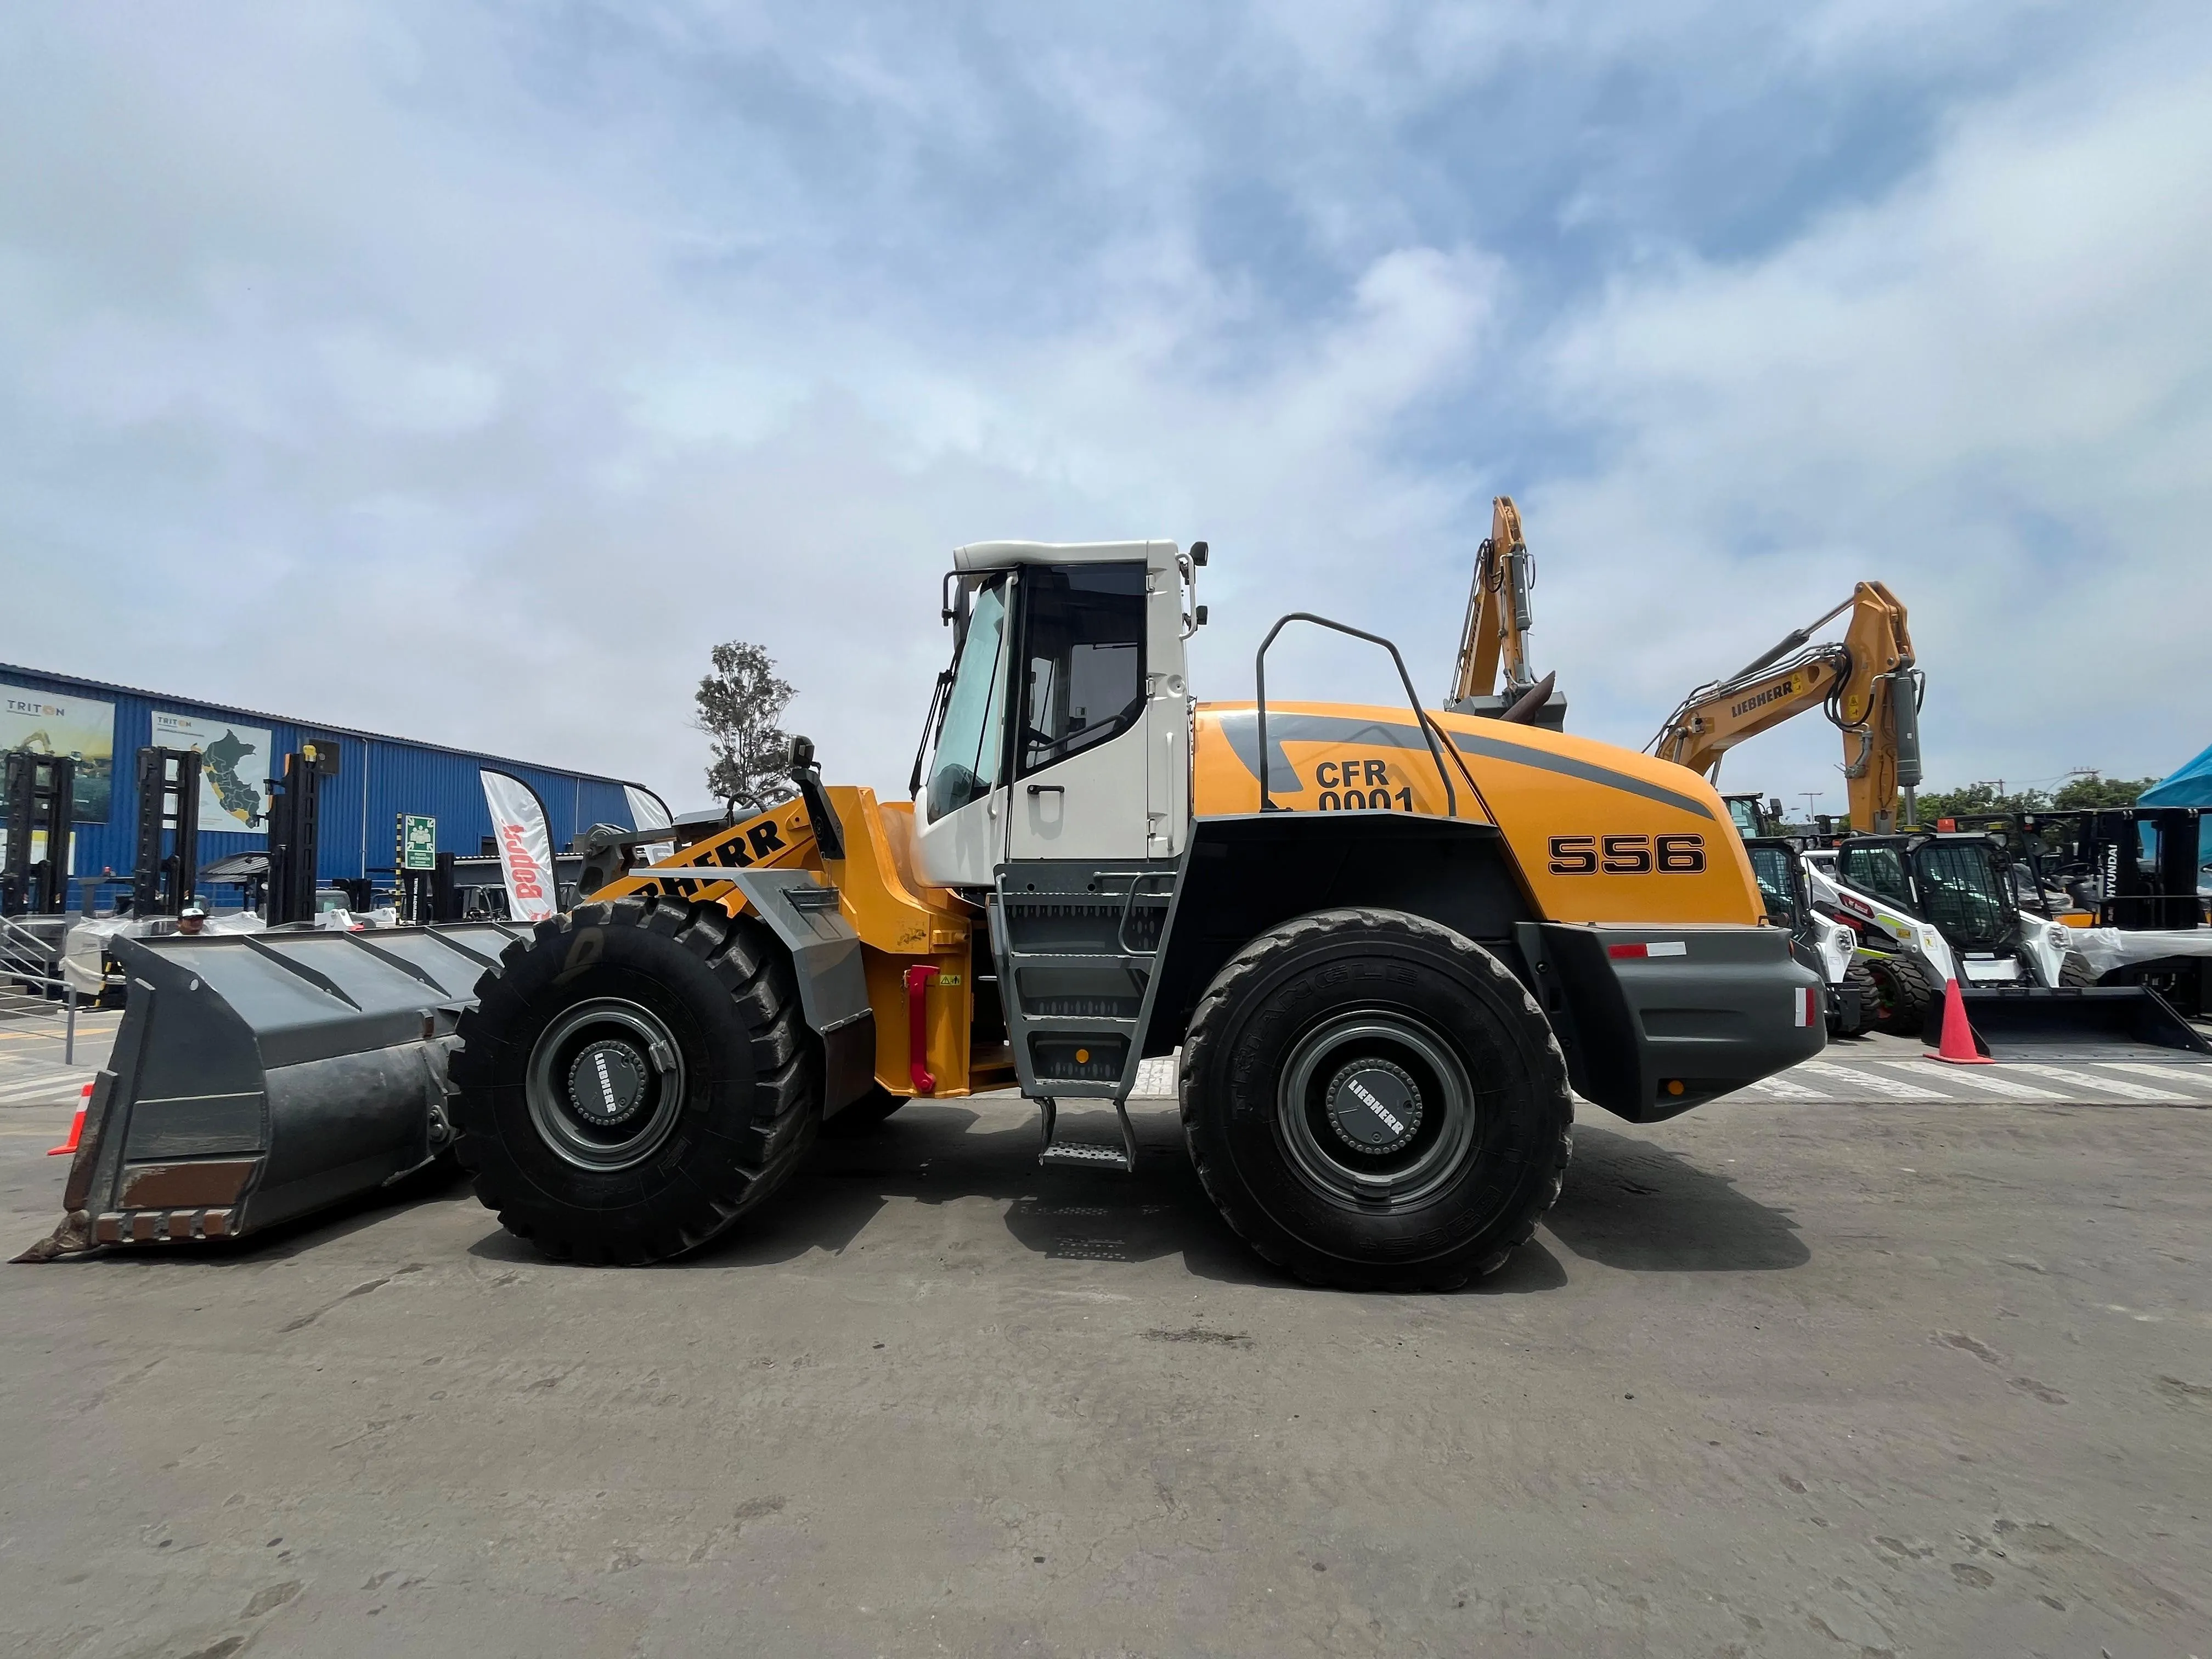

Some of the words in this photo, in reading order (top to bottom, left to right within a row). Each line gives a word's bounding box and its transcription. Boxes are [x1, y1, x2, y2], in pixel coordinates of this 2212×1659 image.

[7, 699, 65, 716] TRITON
[1731, 681, 1793, 718] LIEBHERR
[157, 716, 191, 727] TRITON
[1316, 759, 1389, 788] CFR
[1318, 787, 1413, 812] 0001
[1547, 833, 1707, 876] 556
[2106, 844, 2118, 898] HYUNDAI
[594, 1052, 617, 1113] LIEBHERR
[1347, 1079, 1404, 1135] LIEBHERR
